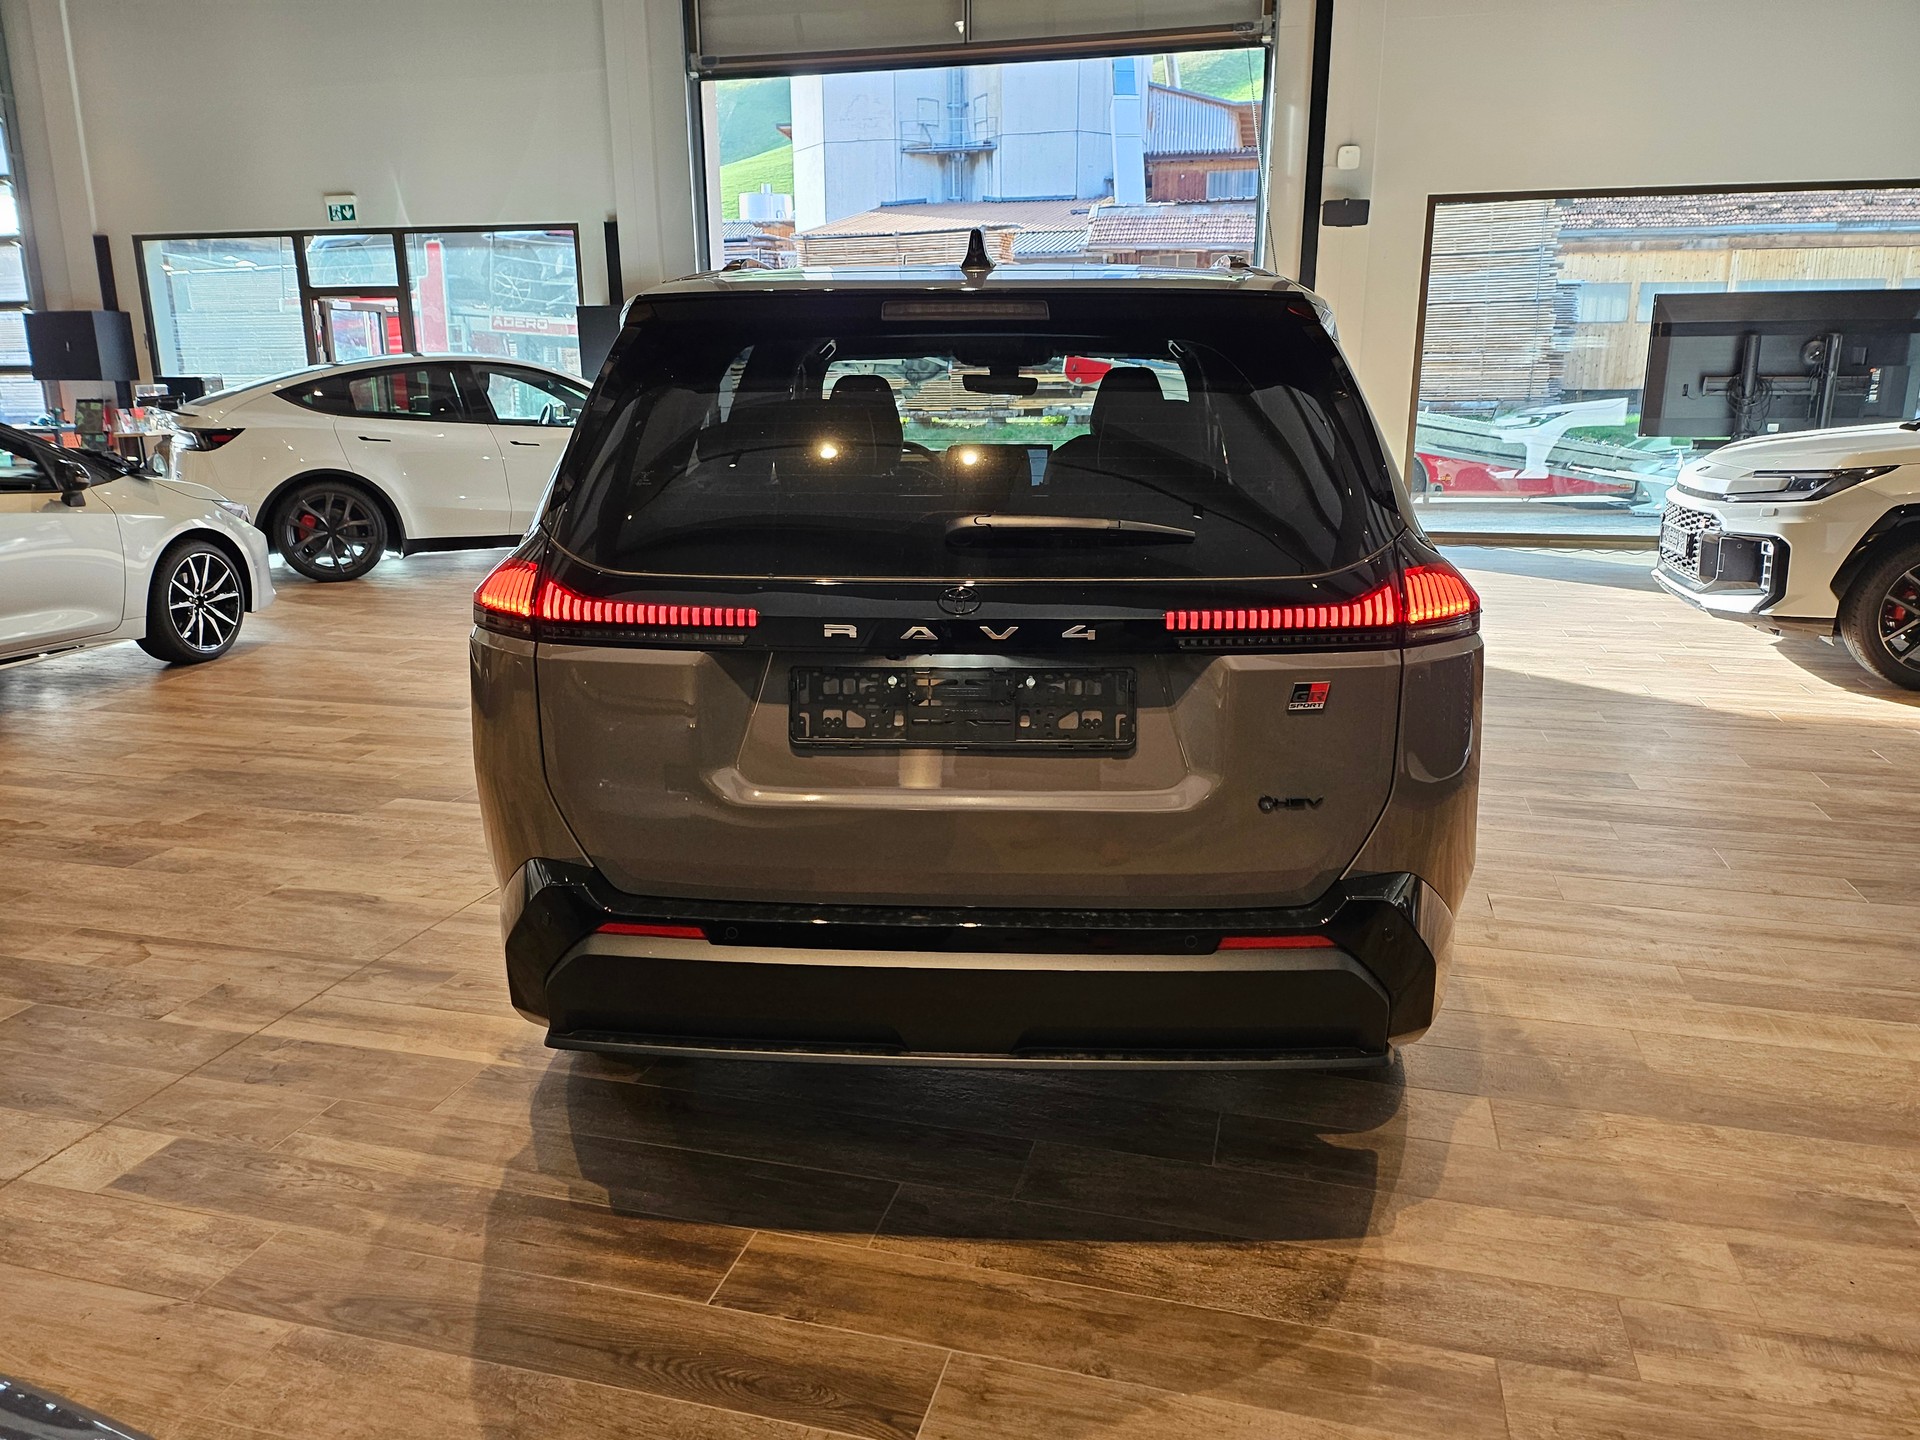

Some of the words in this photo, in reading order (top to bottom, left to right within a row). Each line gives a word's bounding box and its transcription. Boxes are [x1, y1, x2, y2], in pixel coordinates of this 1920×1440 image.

[823, 623, 1097, 641] RAV4
[1292, 690, 1327, 702] GR
[1273, 796, 1324, 810] HEV
